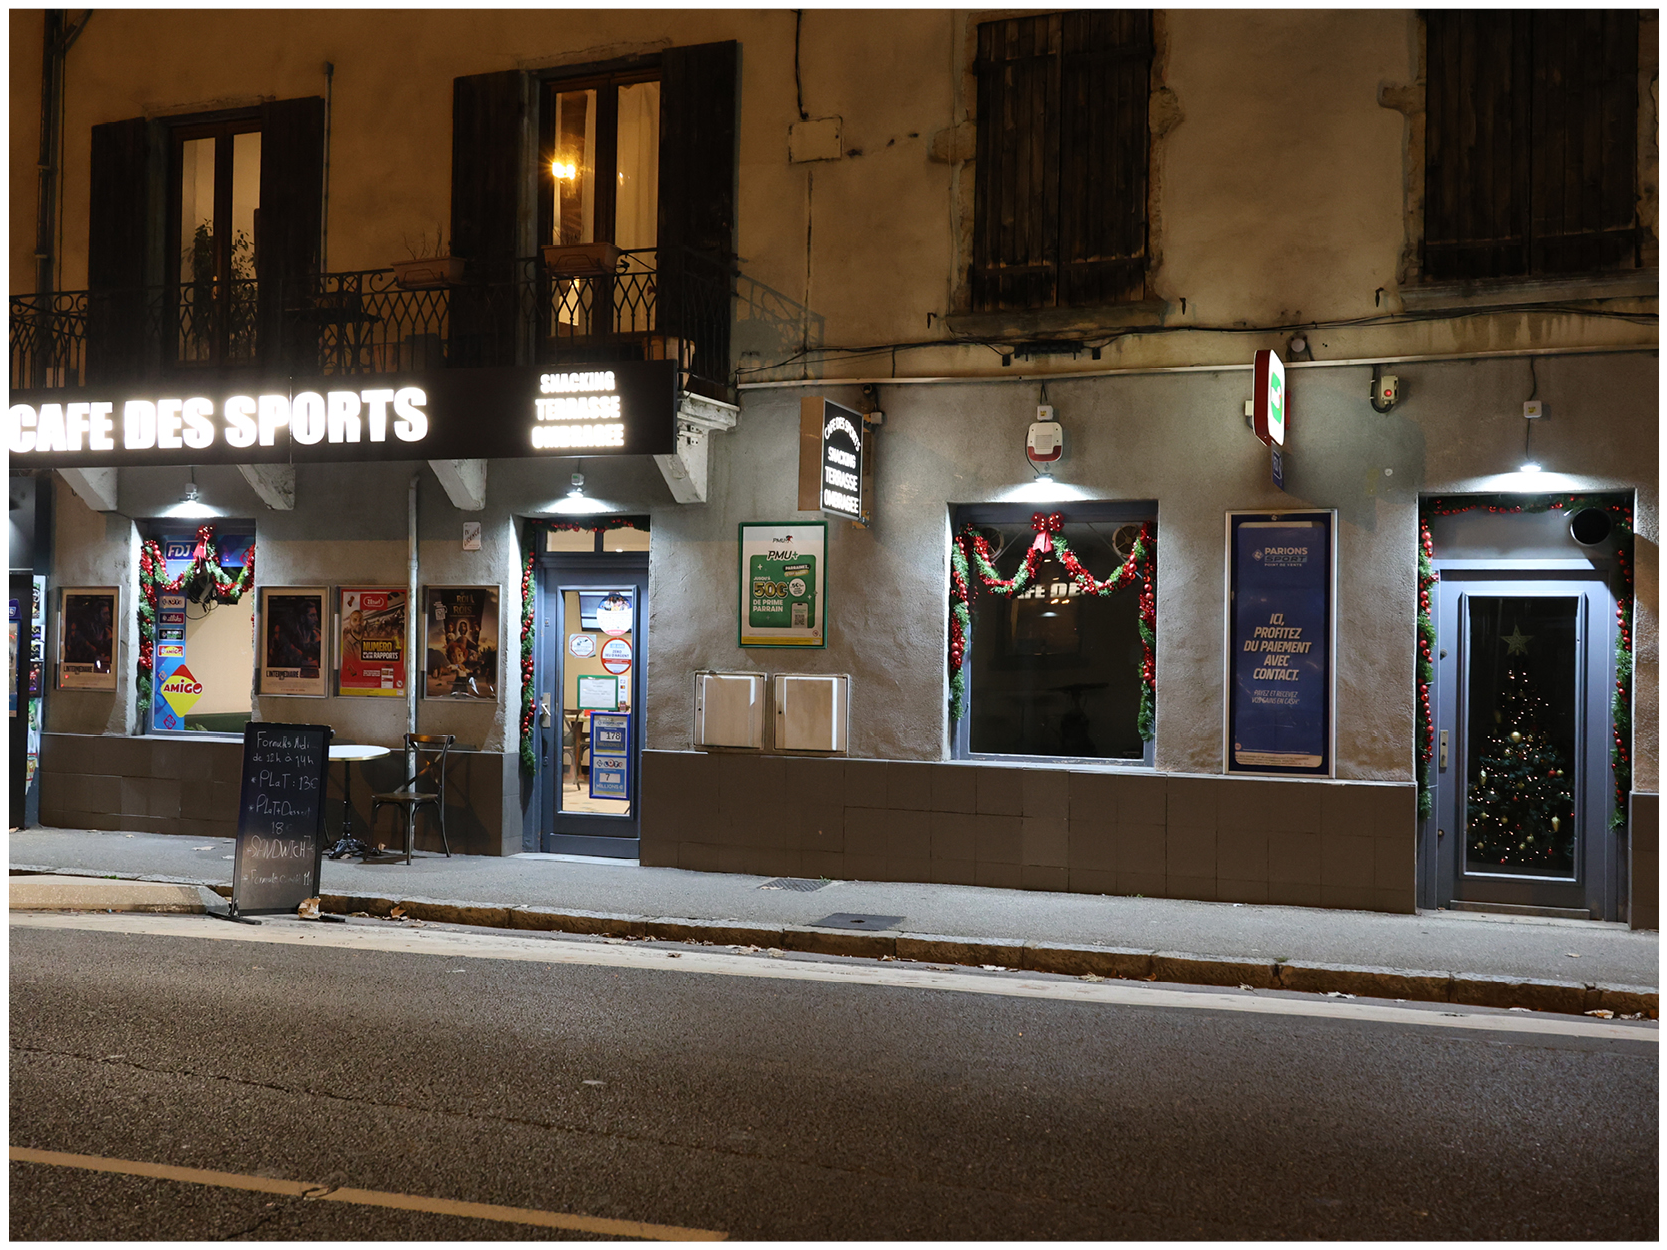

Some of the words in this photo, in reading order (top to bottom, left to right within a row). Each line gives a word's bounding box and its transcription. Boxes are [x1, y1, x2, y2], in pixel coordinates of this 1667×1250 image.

[9, 401, 114, 453] CAFE
[123, 397, 215, 450] DES
[223, 386, 429, 449] SPORTS
[824, 465, 858, 492] TERRASSE
[167, 544, 191, 557] FDJ
[1264, 547, 1308, 555] PARIONS
[1269, 613, 1285, 626] ICI,
[1254, 626, 1302, 640] PROFITEZ
[1243, 640, 1259, 652] DU
[1260, 641, 1312, 654] PAIEMENT
[374, 652, 399, 660] RAPPORTS
[1263, 654, 1290, 667] AVEC
[1252, 668, 1300, 681] CONTACT.
[606, 731, 621, 740] 178
